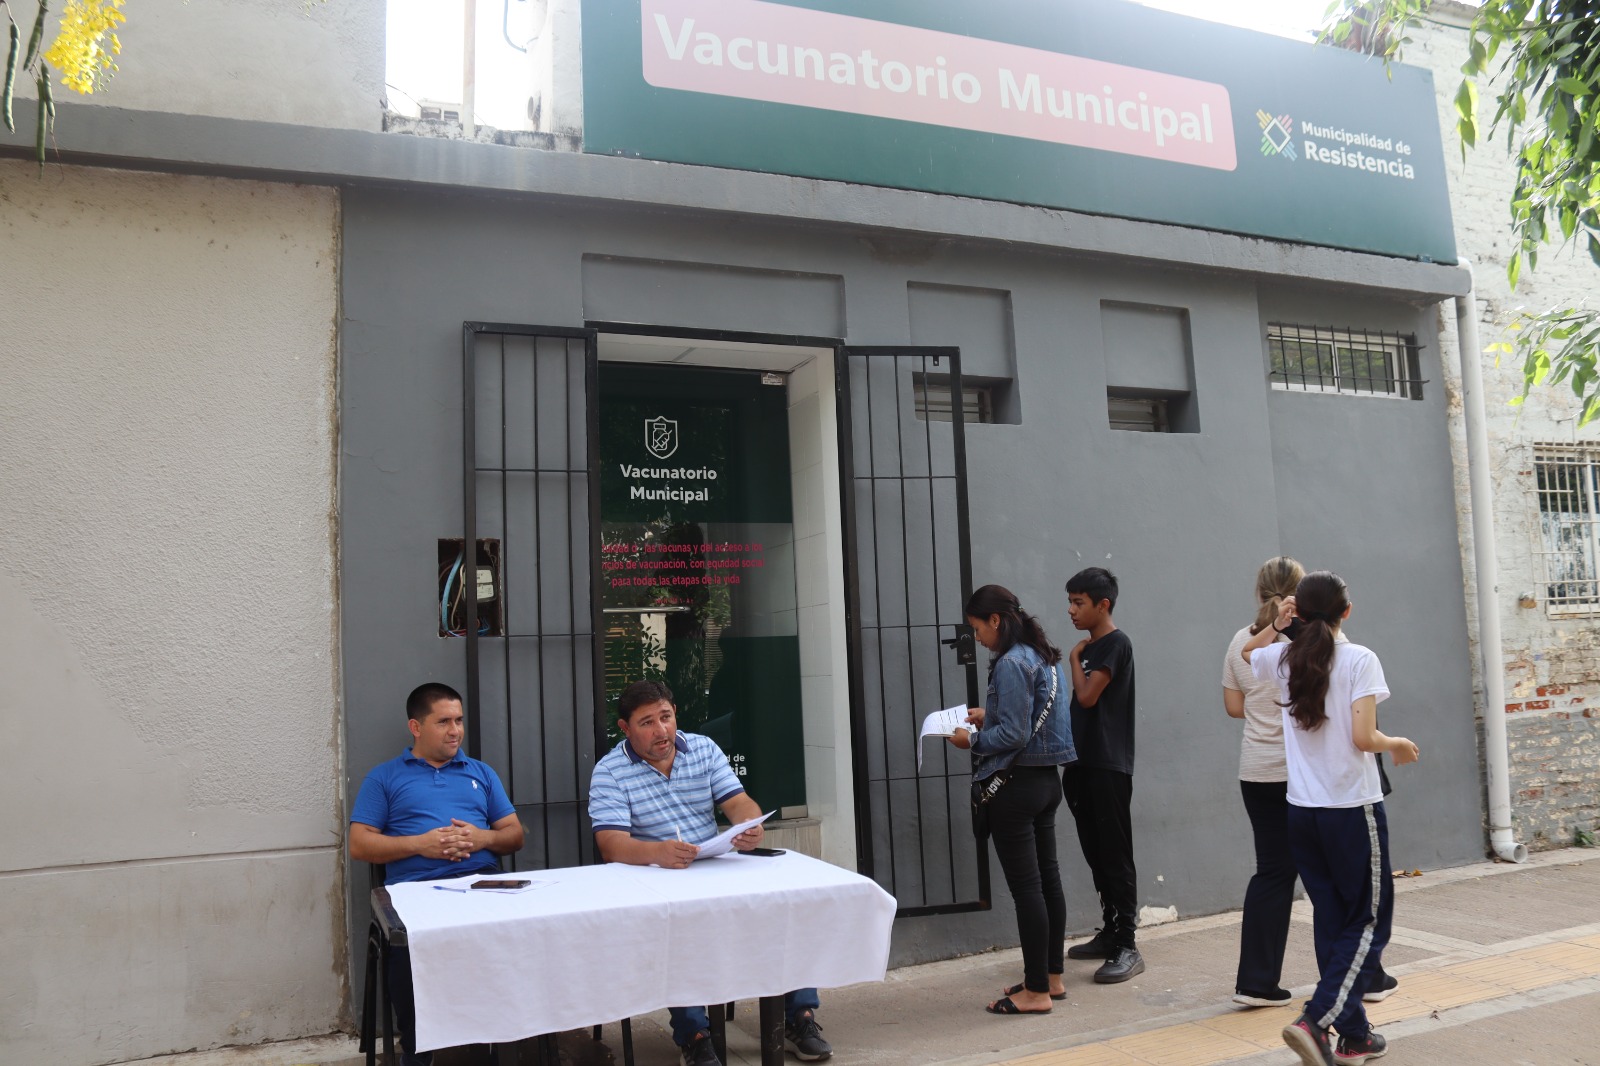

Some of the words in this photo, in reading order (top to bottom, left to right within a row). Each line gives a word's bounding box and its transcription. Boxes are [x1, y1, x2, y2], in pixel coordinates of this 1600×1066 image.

[653, 13, 982, 104] Vacunatorio
[998, 68, 1213, 147] Municipal
[1301, 121, 1392, 151] Municipalidad
[1395, 141, 1411, 155] de
[1304, 140, 1415, 179] Resistencia
[619, 463, 718, 480] Vacunatorio
[630, 486, 709, 504] Municipal
[658, 543, 692, 553] vacunas
[693, 544, 699, 555] y
[700, 542, 713, 553] del
[715, 543, 743, 553] acceso
[744, 544, 751, 552] a
[626, 559, 637, 569] de
[639, 558, 688, 570] vacunación,
[689, 560, 705, 569] con
[707, 558, 740, 570] equidad
[742, 557, 765, 568] social
[611, 577, 631, 589] para
[633, 575, 657, 586] todas
[659, 575, 670, 586] las
[672, 575, 700, 587] etapas
[701, 574, 712, 585] de
[714, 573, 721, 584] la
[723, 573, 740, 584] vida
[733, 753, 746, 762] de
